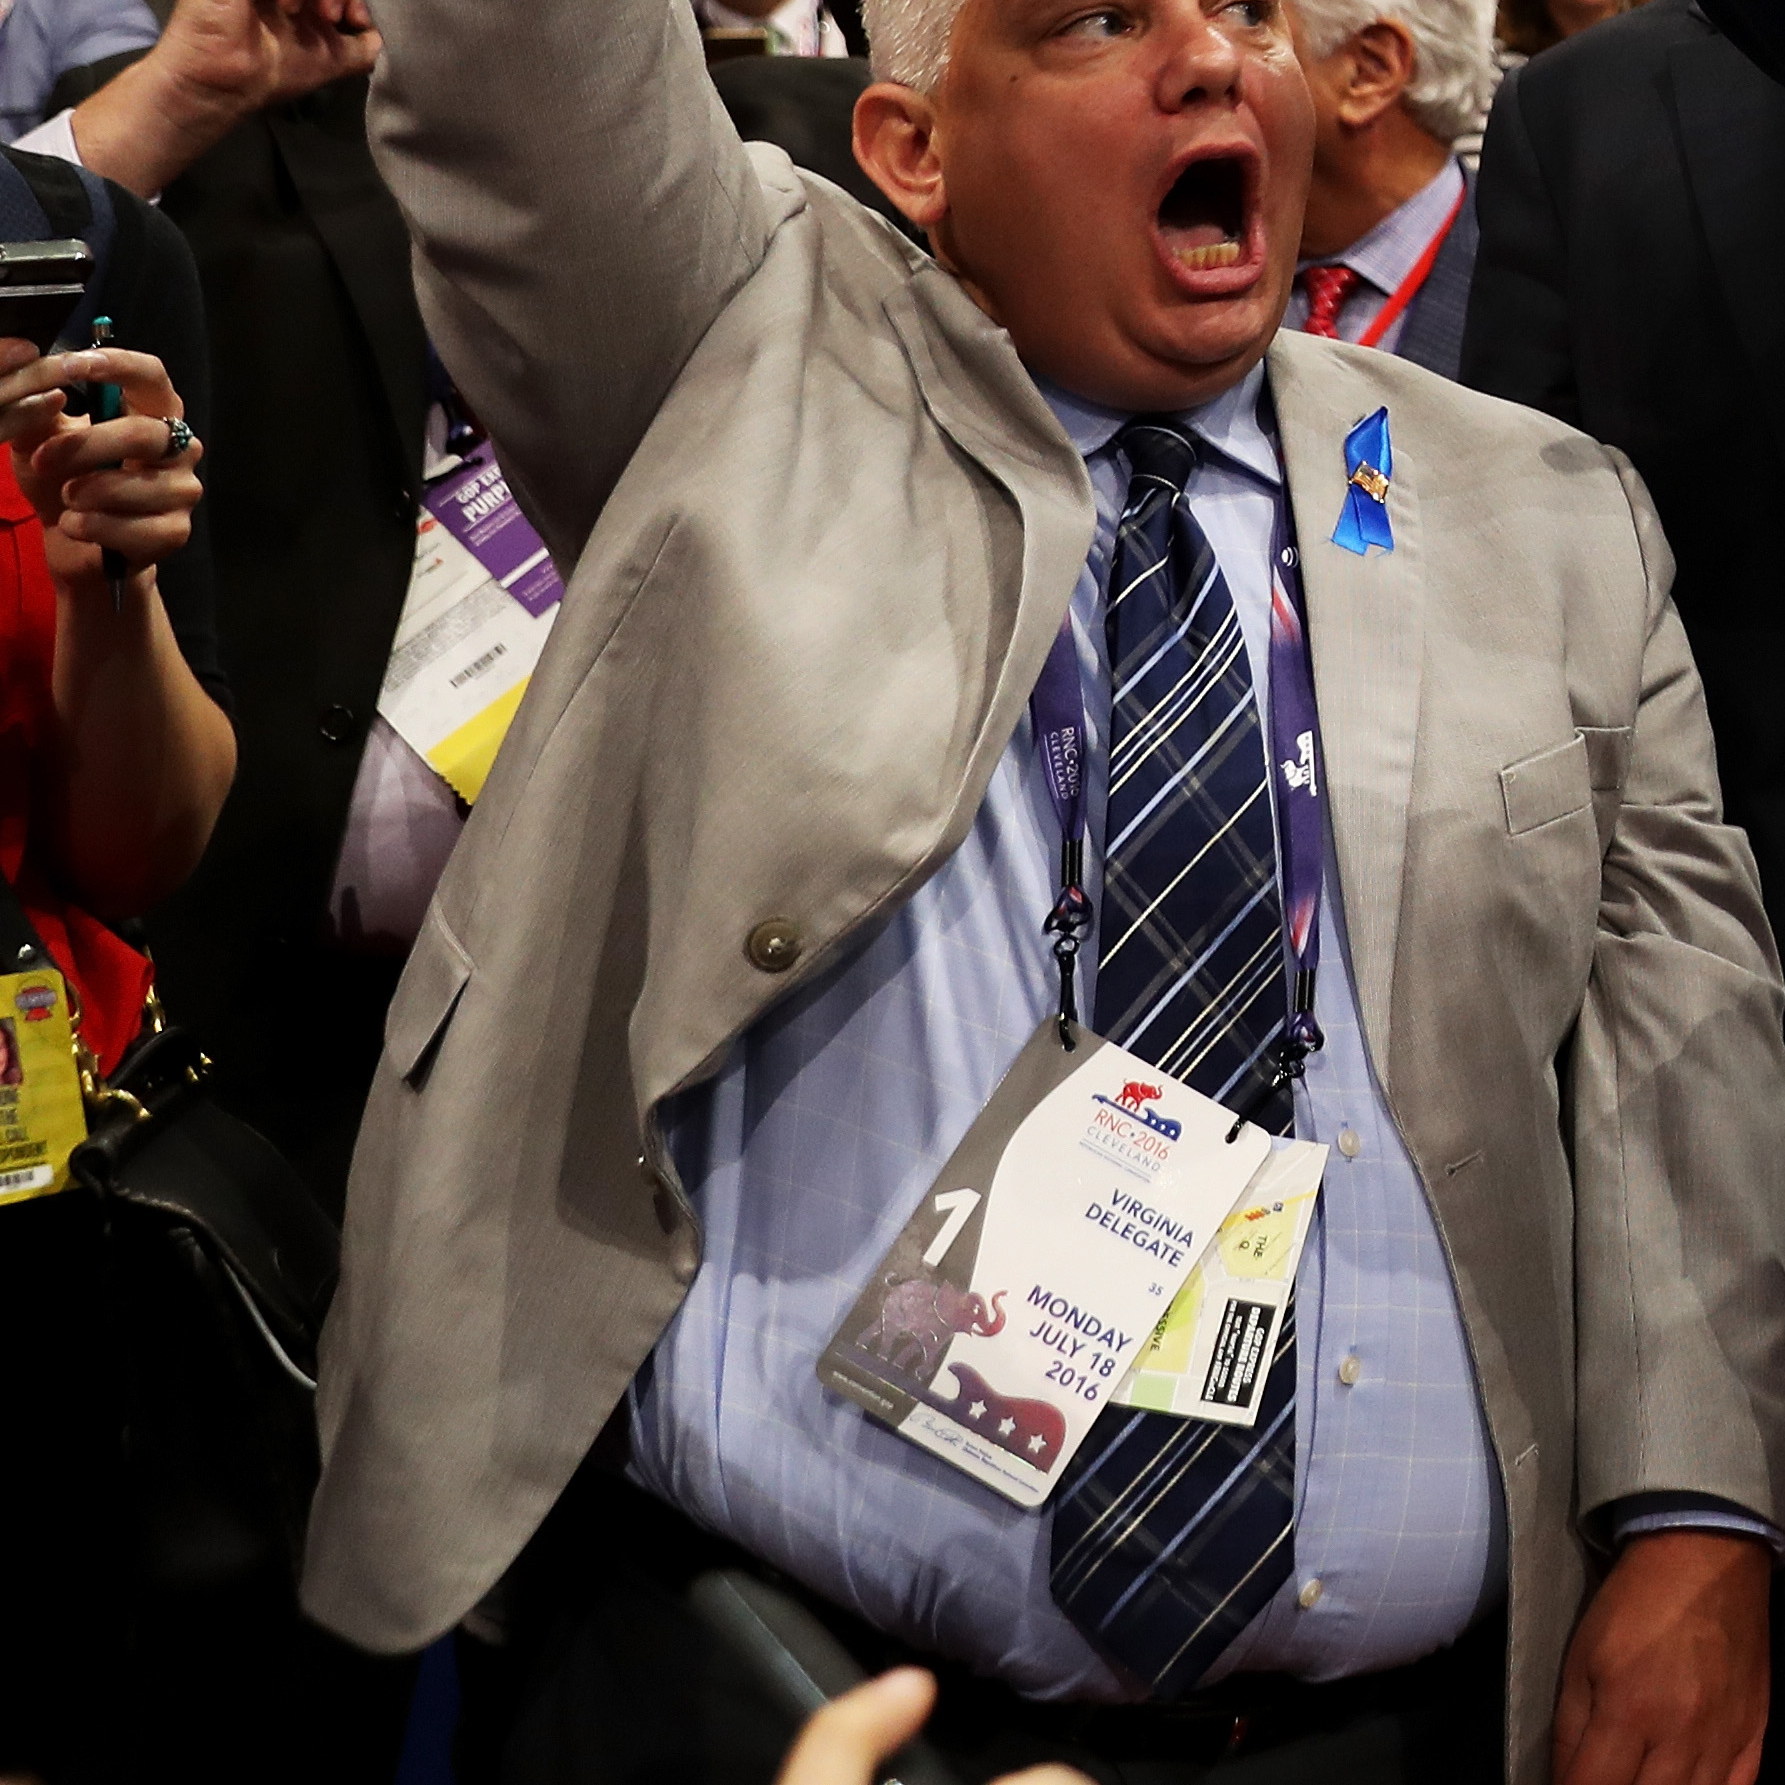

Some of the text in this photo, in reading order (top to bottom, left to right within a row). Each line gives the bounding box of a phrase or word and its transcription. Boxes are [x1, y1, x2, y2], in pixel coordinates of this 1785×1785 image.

[1048, 730, 1070, 800] CLEVELAND
[1086, 1125, 1161, 1172] CLEVELAND
[922, 1187, 982, 1267] 1
[1085, 1201, 1185, 1268] DELEGATE
[1110, 1187, 1195, 1248] VIRGINIA
[1253, 1234, 1268, 1258] THE
[1148, 1281, 1165, 1296] 35
[1026, 1284, 1135, 1354] MONDAY
[1028, 1320, 1116, 1378] JULY 18
[1045, 1360, 1099, 1402] 2016
